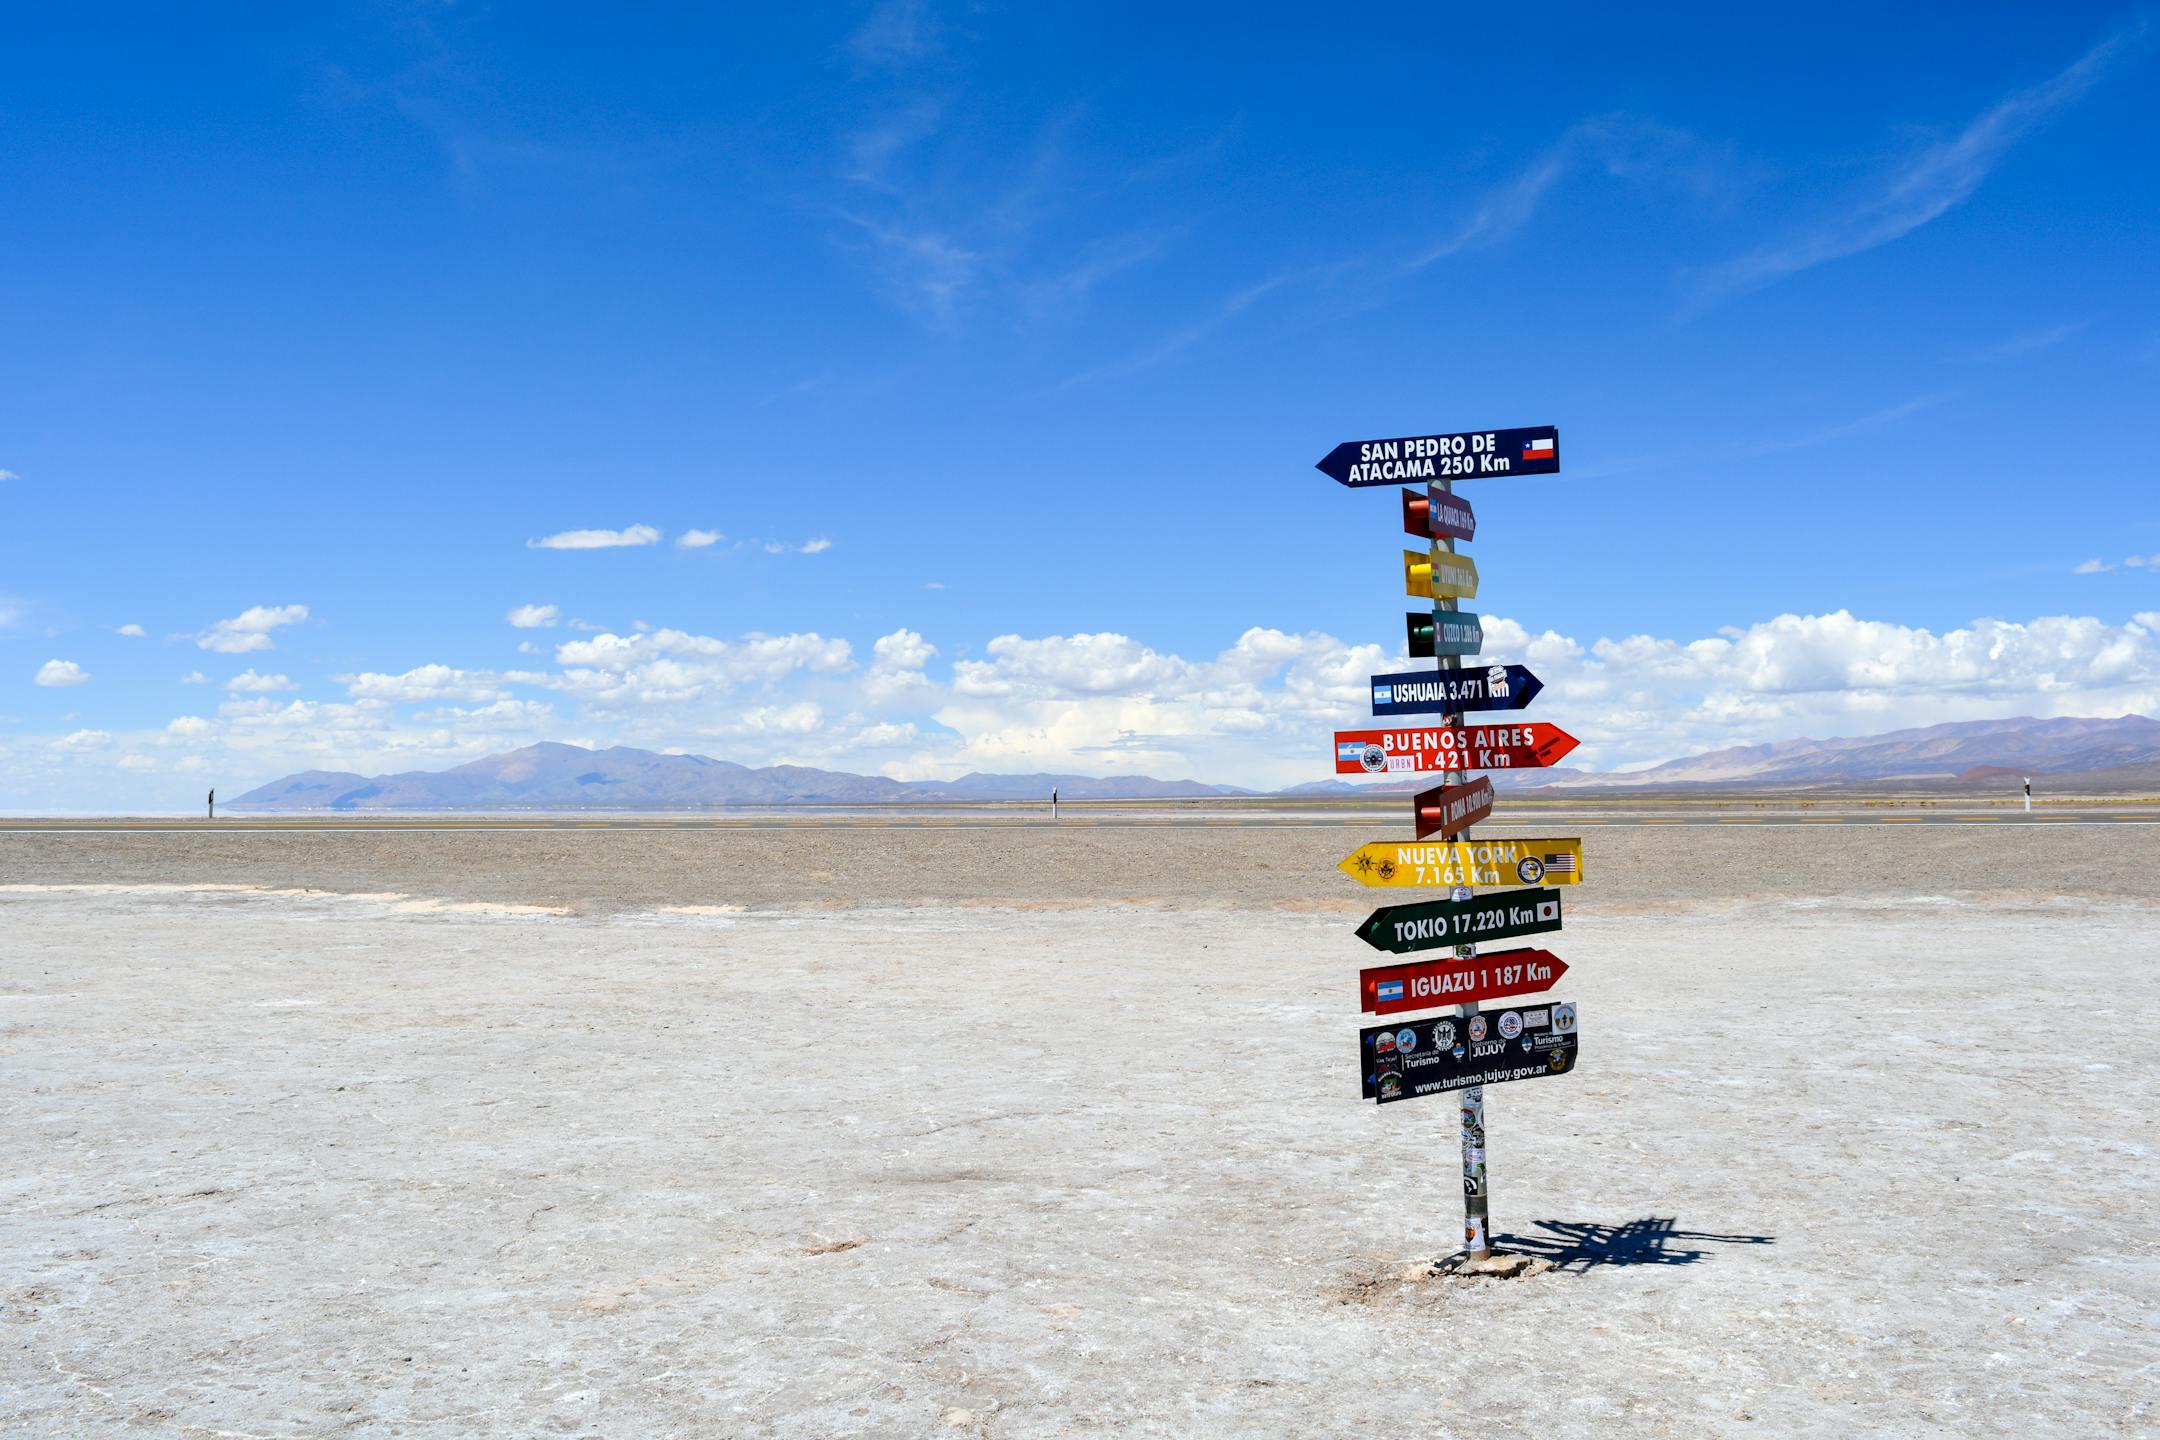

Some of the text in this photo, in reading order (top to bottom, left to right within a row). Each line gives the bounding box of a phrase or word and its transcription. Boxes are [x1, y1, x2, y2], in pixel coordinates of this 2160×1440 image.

[1360, 433, 1496, 462] SAN PEDRO DE
[1348, 453, 1510, 482] ATACAMA 250 Km
[1443, 623, 1460, 642] CUZCO
[1472, 625, 1480, 642] Km
[1393, 682, 1447, 703] USHUAIA
[1449, 679, 1482, 700] 3.471
[1382, 728, 1535, 751] BUENOS AIRES
[1415, 749, 1510, 770] 1.421 Km
[1397, 846, 1517, 865] NUEVA YORK
[1416, 866, 1465, 884] 7.165
[1471, 866, 1500, 884] Km
[1394, 906, 1534, 942] TOKIO 17.220 Km
[1411, 970, 1475, 998] IGUAZU
[1527, 962, 1551, 982] Km
[1472, 1039, 1498, 1049] Gobierno
[1472, 1042, 1506, 1058] JUJUY
[1534, 1034, 1564, 1046] Turismo
[1405, 1055, 1440, 1069] Turismo
[1415, 1063, 1547, 1094] www.turismo.jujuy.gov.ar
